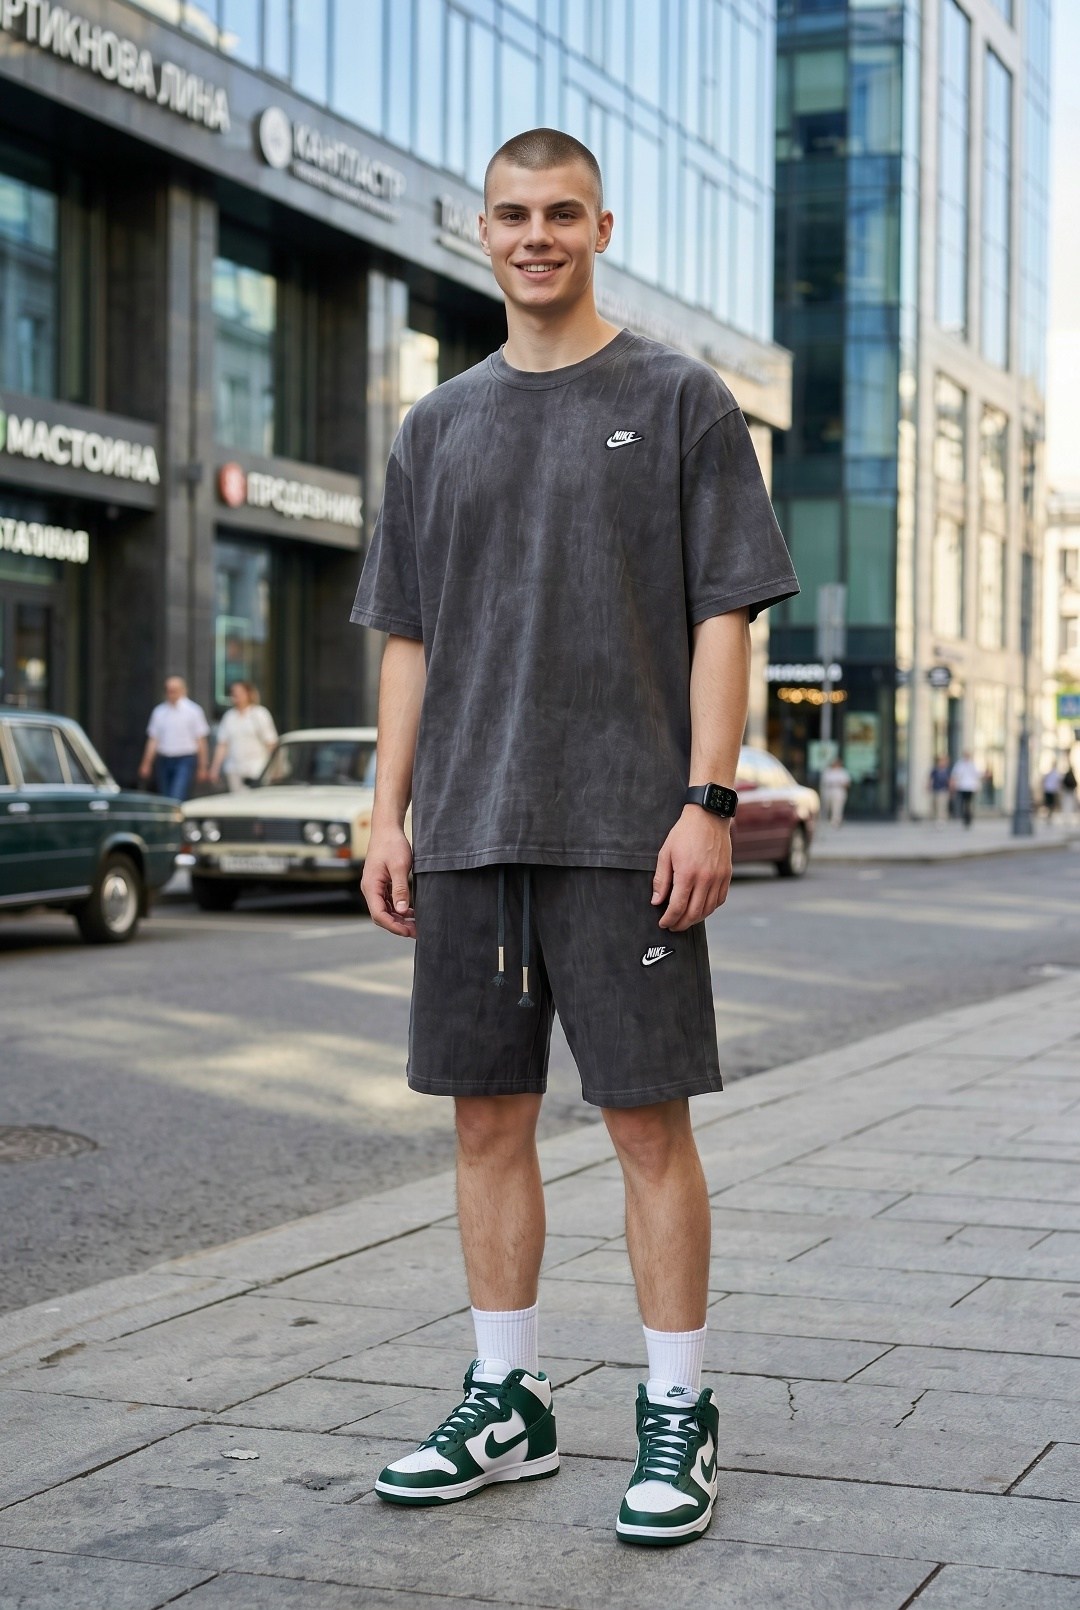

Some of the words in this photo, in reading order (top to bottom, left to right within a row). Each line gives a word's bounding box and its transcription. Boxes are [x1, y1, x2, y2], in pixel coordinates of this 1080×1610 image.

[613, 430, 636, 440] NIKE
[6, 414, 161, 486] МАСТОИНА
[646, 946, 666, 958] NIKE
